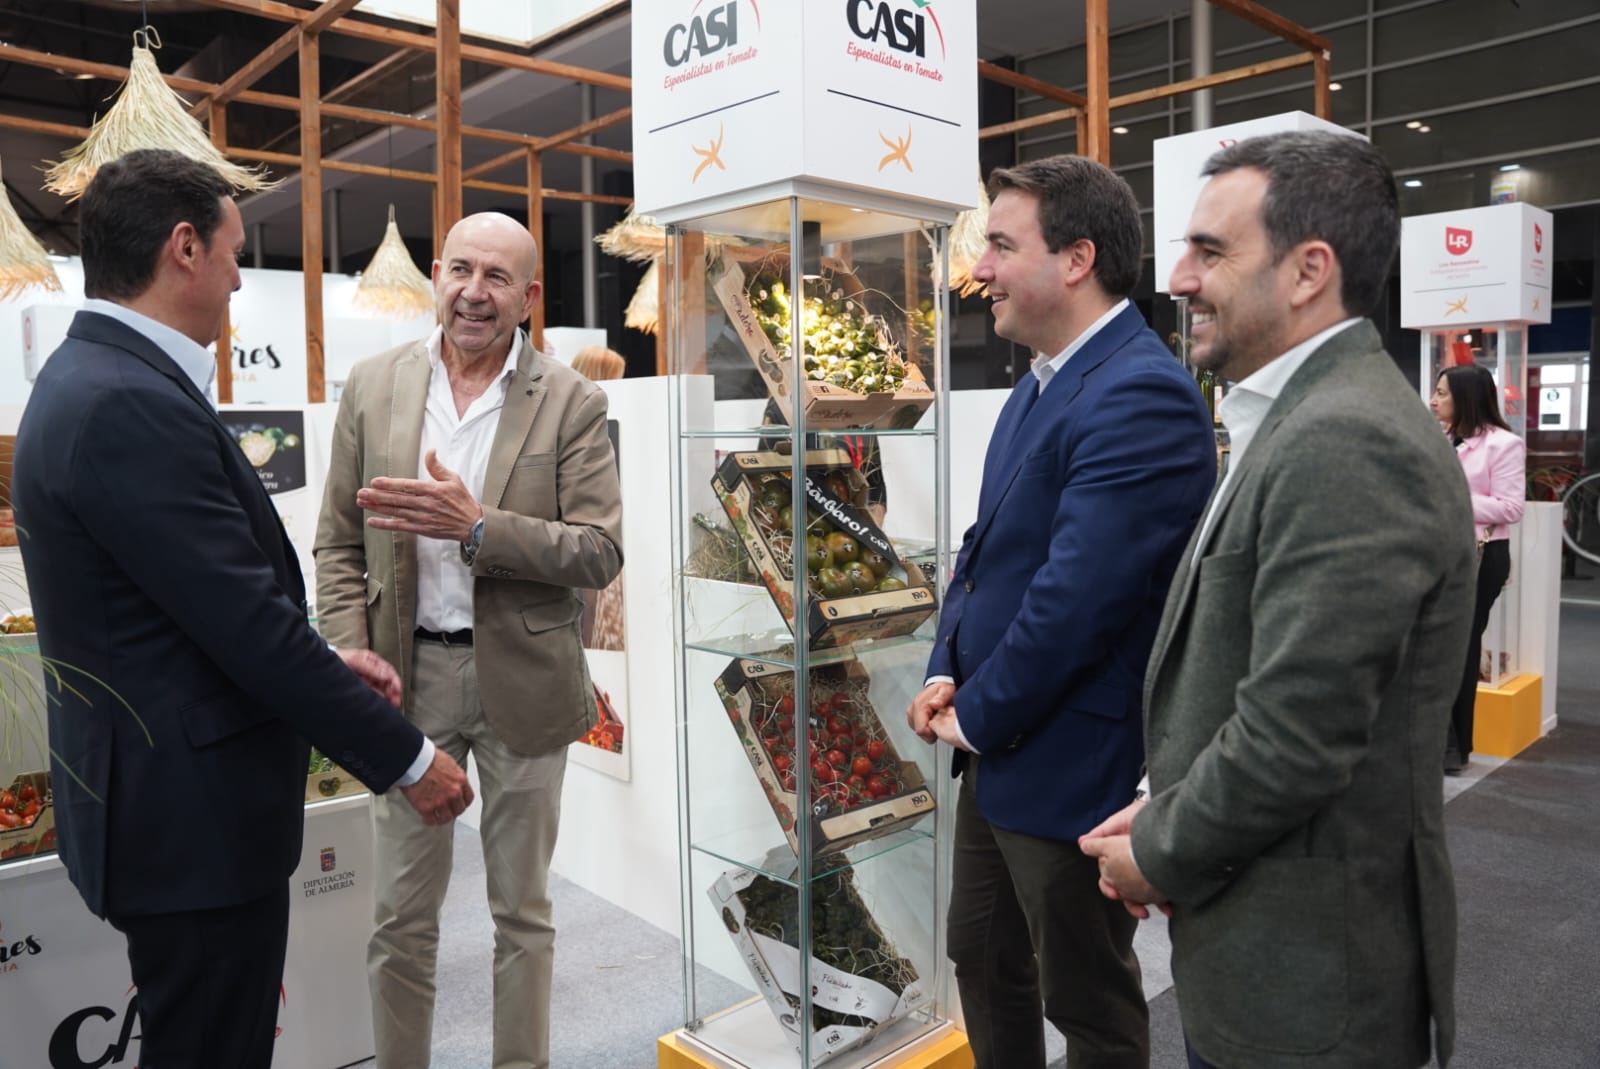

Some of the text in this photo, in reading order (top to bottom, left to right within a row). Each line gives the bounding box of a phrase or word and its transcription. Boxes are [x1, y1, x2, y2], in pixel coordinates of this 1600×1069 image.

[663, 0, 738, 67] CASI
[846, 0, 925, 58] CASI
[663, 46, 758, 91] Especialistas en Tomate
[847, 41, 944, 82] Especialistas en Tomate
[305, 888, 316, 898] DE
[48, 994, 142, 1069] CA
